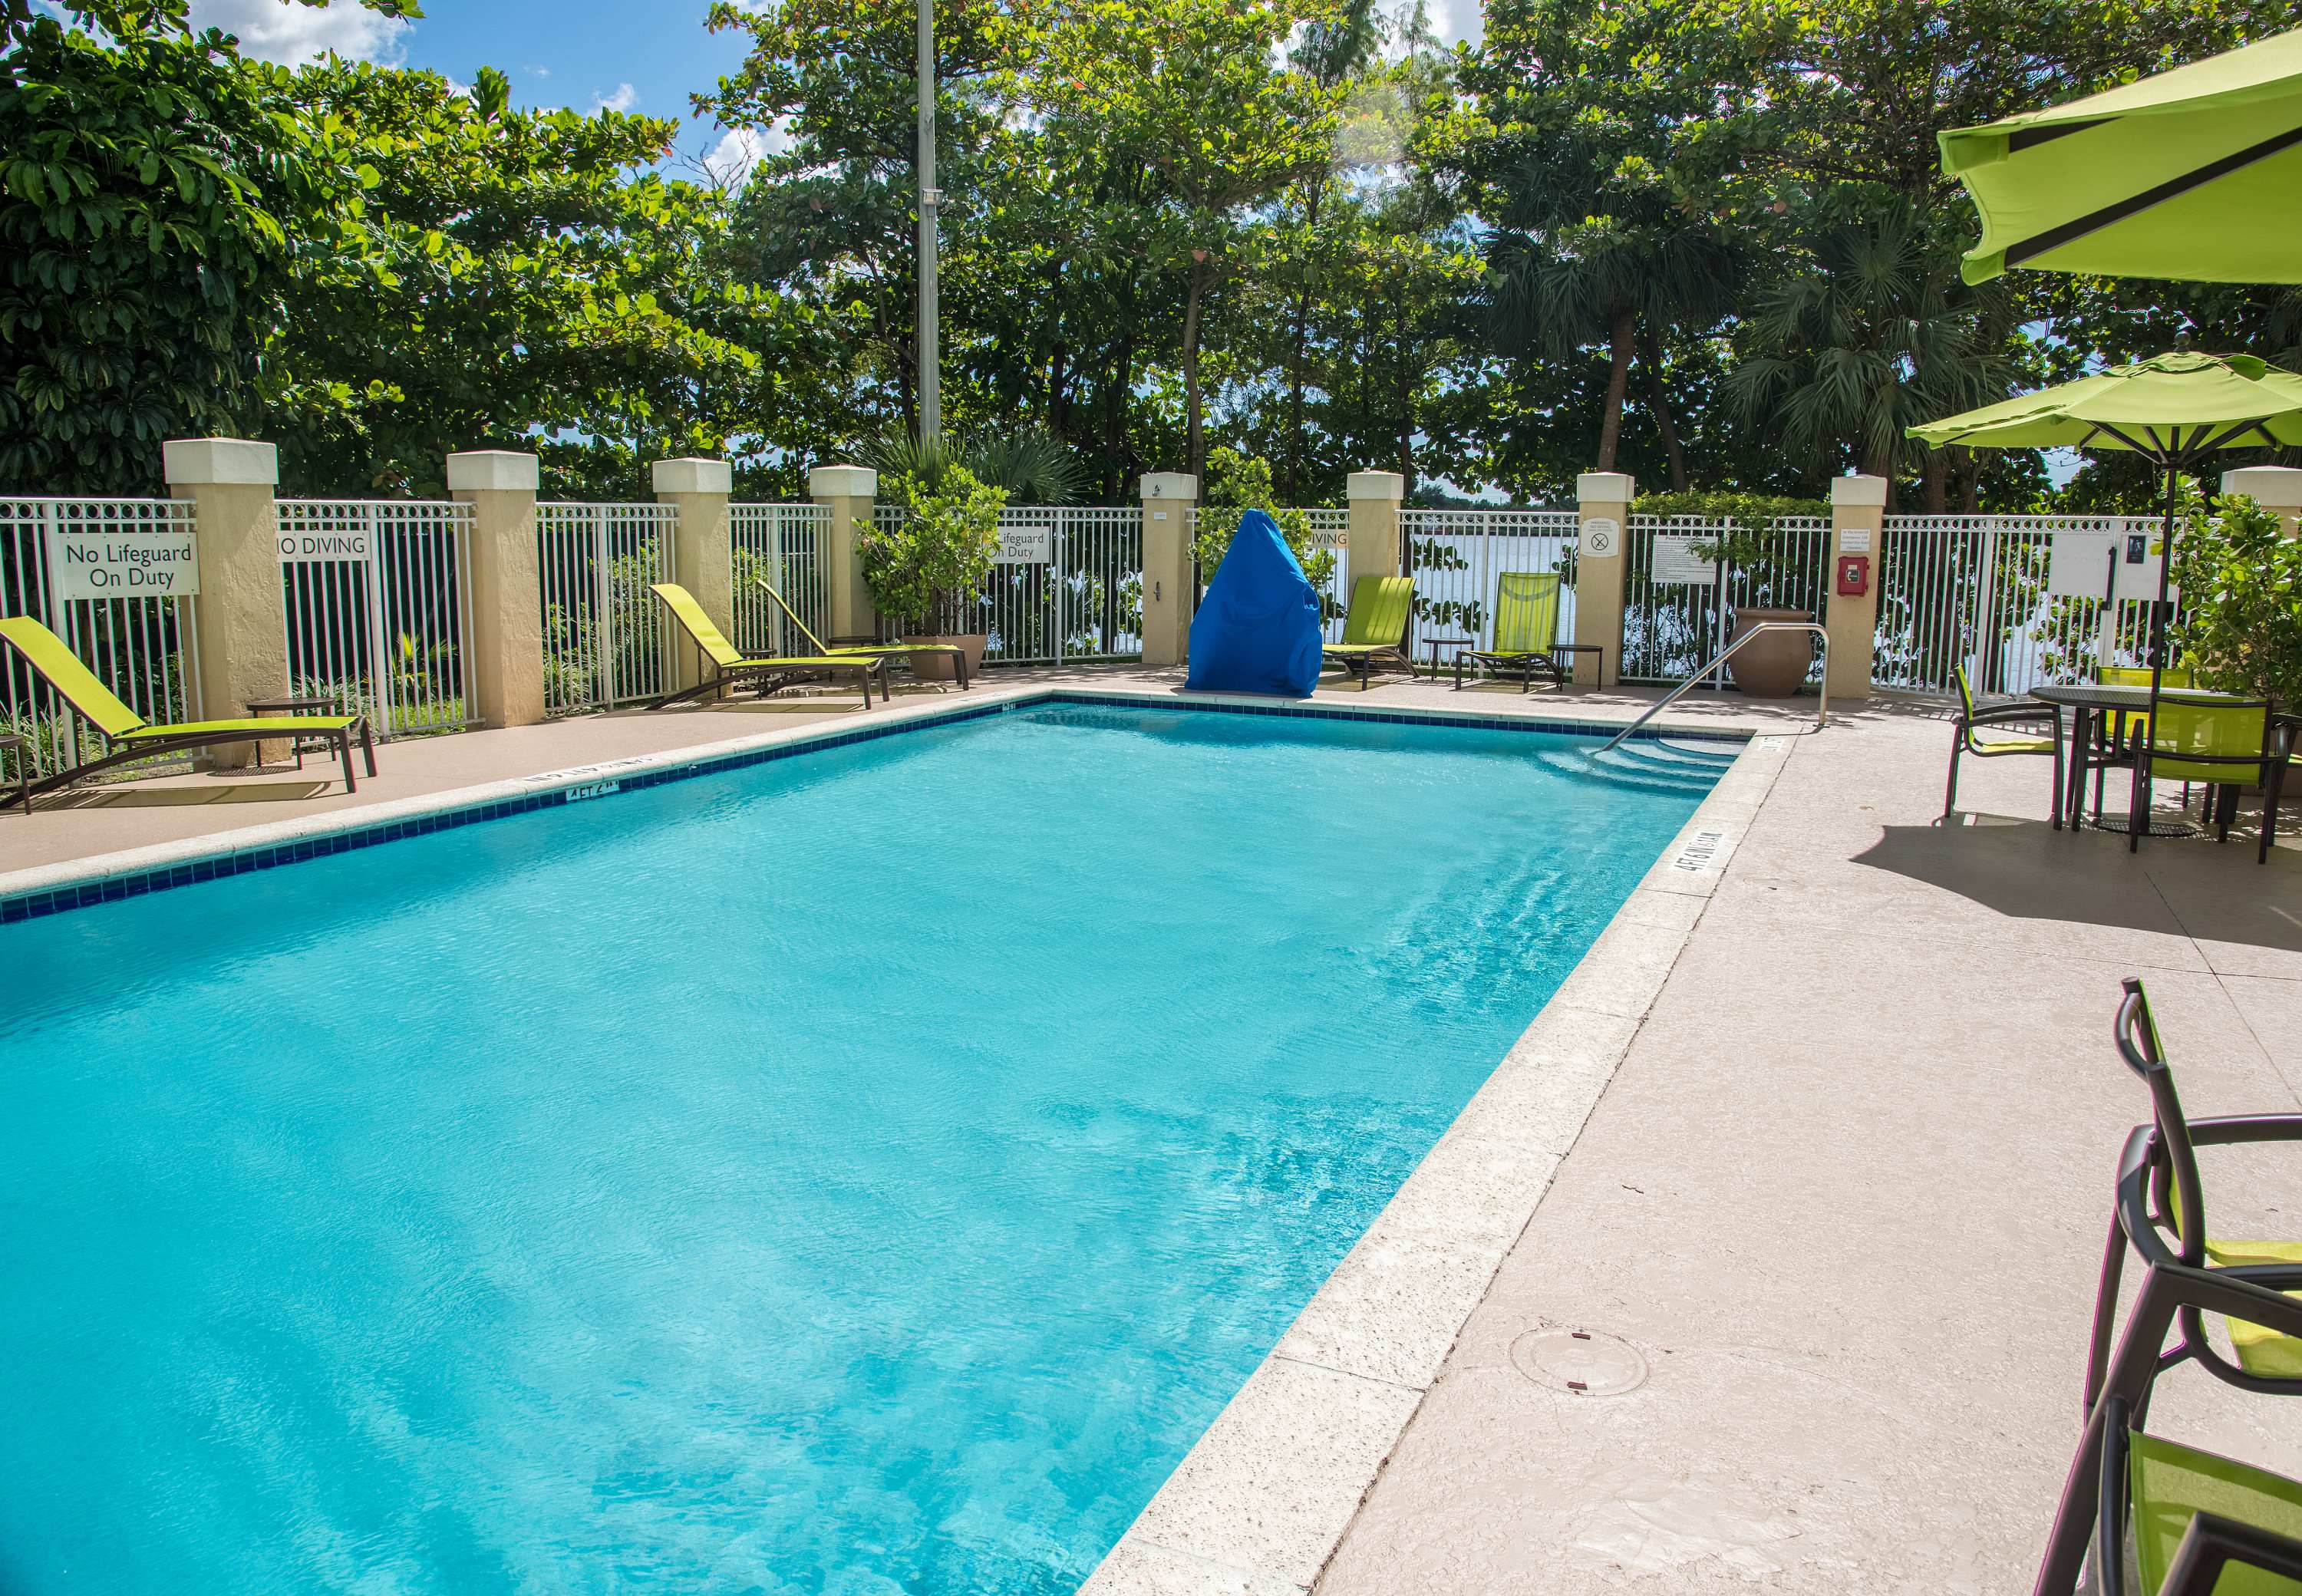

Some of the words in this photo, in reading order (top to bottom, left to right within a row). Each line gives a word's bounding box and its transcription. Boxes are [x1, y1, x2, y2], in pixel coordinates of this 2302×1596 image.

[276, 537, 296, 554] O
[302, 537, 365, 554] DIVING
[1309, 533, 1347, 544] IVING
[67, 544, 99, 563] No
[107, 543, 191, 567] Lifeguard
[1008, 546, 1034, 559] Duty
[90, 568, 120, 587] On
[129, 568, 174, 590] Duty
